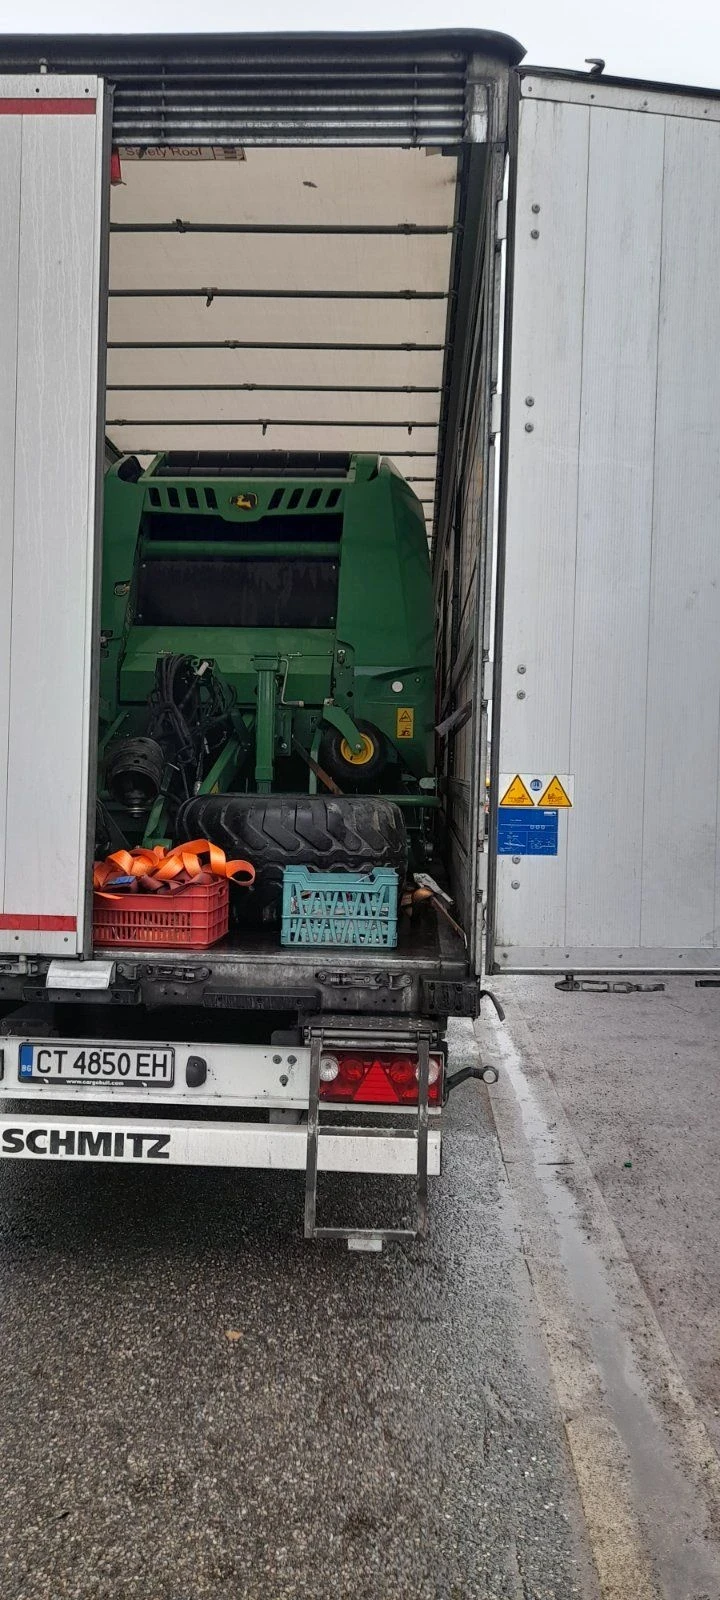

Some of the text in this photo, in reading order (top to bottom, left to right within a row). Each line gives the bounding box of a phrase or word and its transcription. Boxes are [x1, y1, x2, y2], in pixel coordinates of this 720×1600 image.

[125, 146, 167, 157] Sfety
[36, 1050, 167, 1078] CT 4850 EH
[2, 1128, 171, 1159] SCHMITZ
